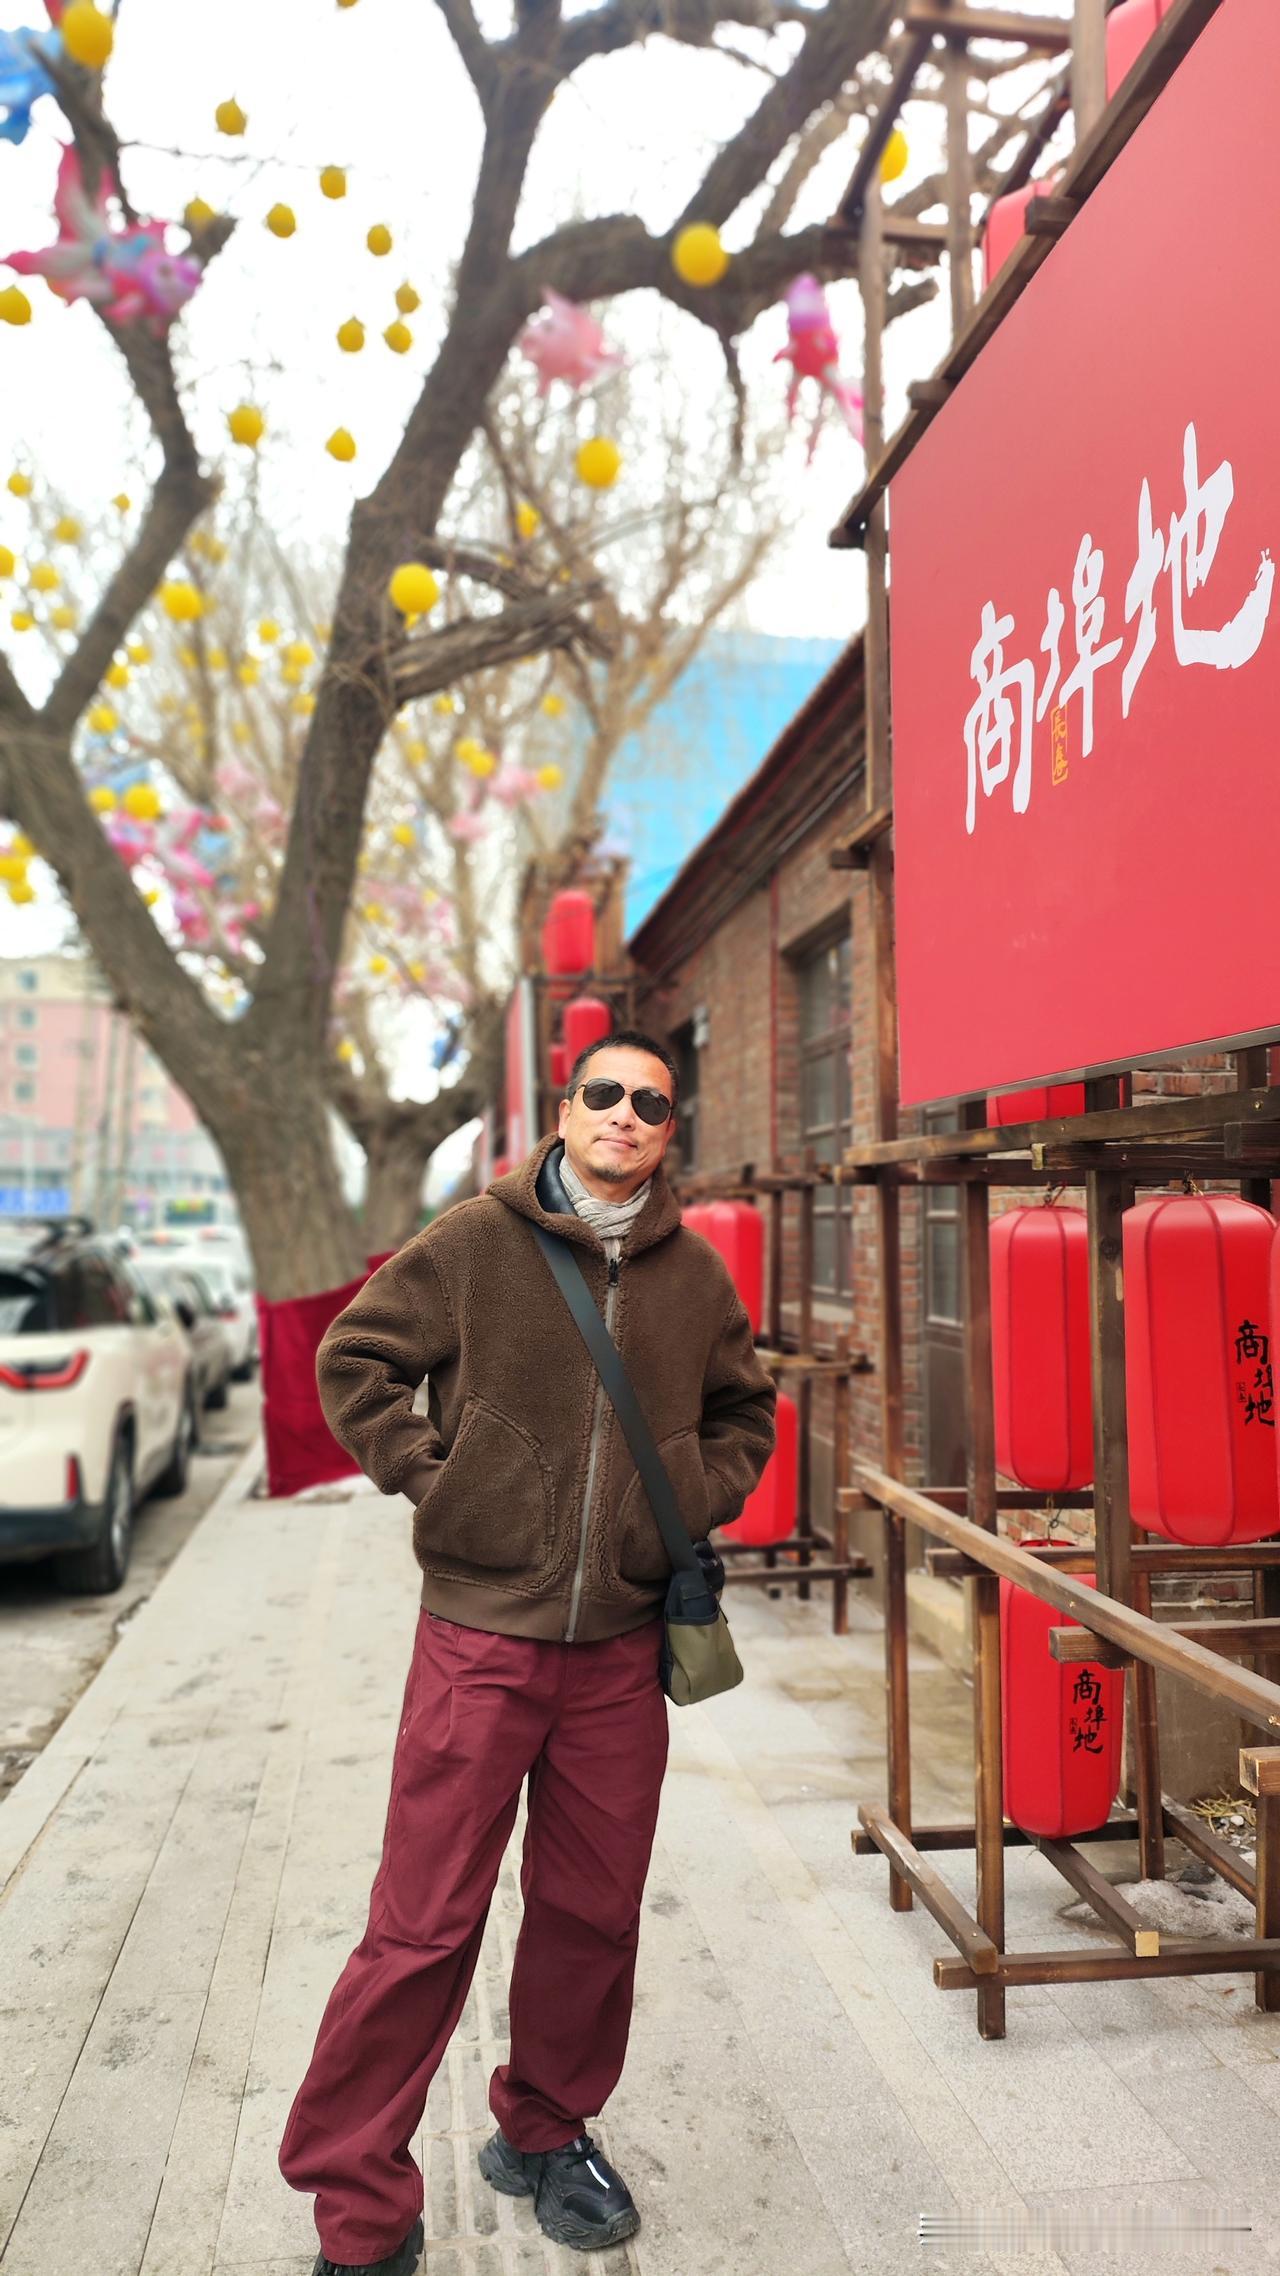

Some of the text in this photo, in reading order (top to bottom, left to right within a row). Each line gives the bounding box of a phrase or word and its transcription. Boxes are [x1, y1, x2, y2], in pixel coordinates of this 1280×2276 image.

[964, 422, 1275, 835] 商埠地
[1073, 1669, 1107, 1754] 商埠地
